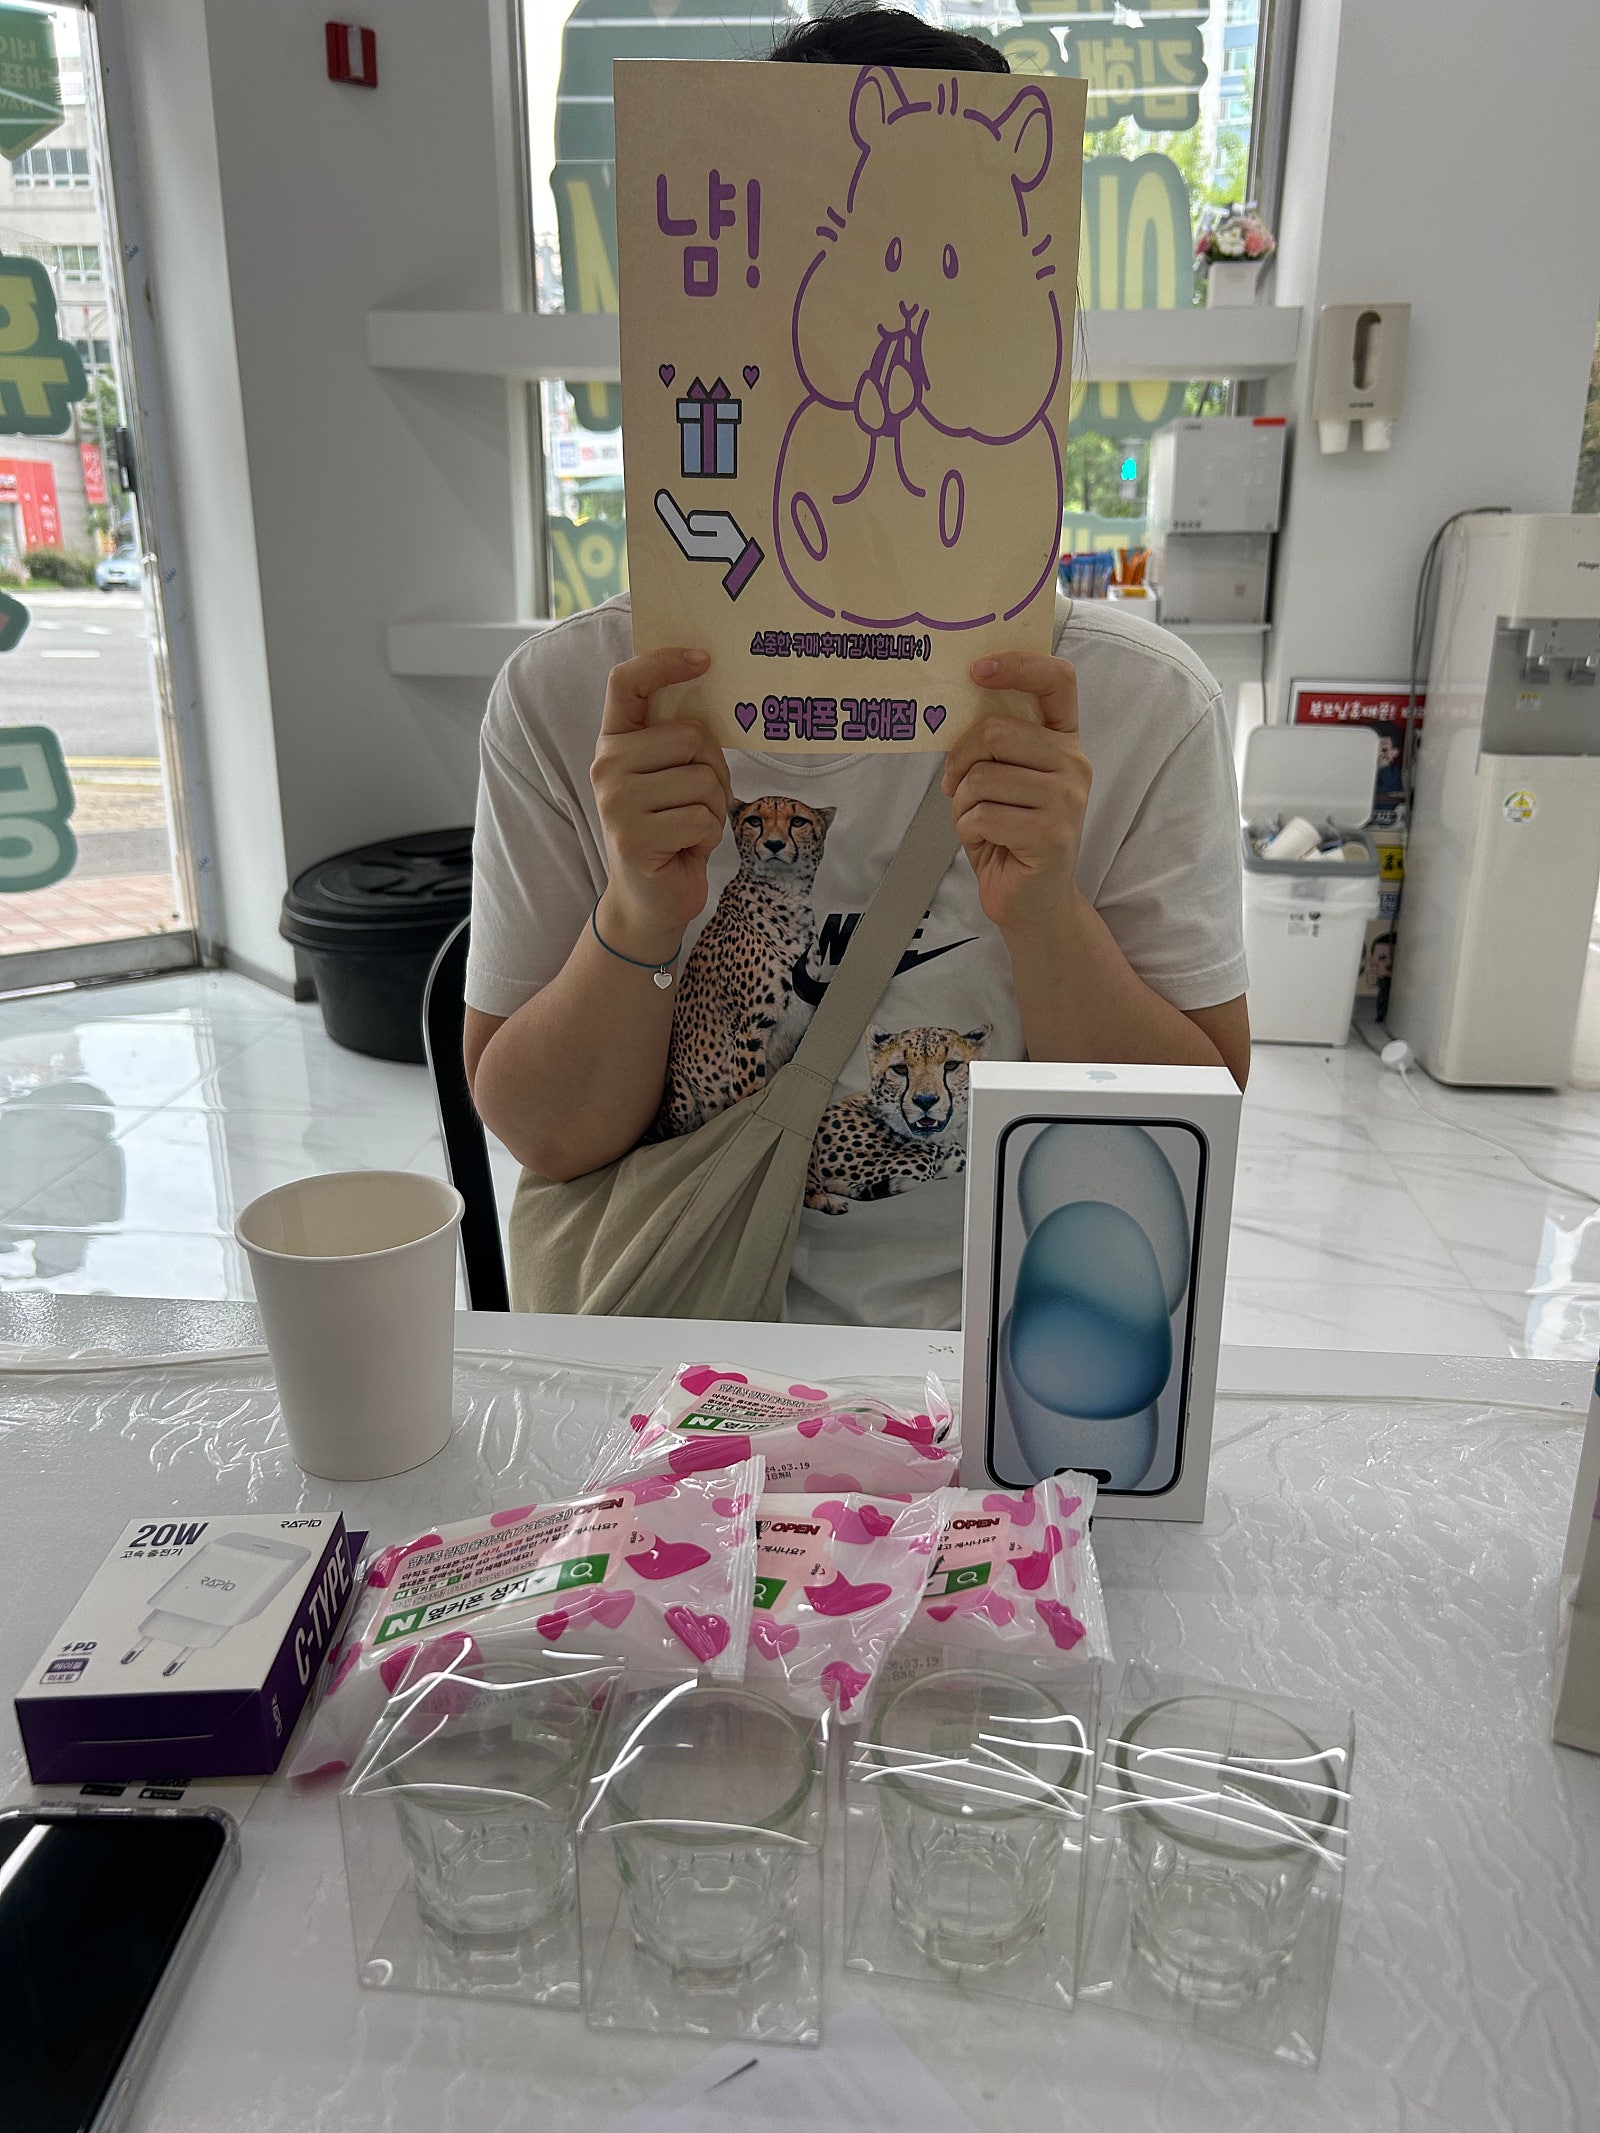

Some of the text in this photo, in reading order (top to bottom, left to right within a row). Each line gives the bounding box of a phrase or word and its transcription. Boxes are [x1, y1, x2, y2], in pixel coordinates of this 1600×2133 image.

[657, 169, 760, 297] 냠!
[750, 631, 791, 658] 소중한
[792, 633, 820, 658] 구매
[821, 633, 848, 659] 후기
[762, 696, 917, 741] 옆커폰 김해점
[574, 1498, 625, 1516] OPEN
[129, 1518, 322, 1548] 20W RAPID
[771, 1522, 820, 1535] OPEN
[953, 1518, 1000, 1529] OPEN
[120, 1547, 184, 1559] 고속 충전기
[398, 1578, 428, 1590] 휴대폰
[539, 1537, 550, 1547] 거
[474, 1550, 535, 1577] 검색해보세요!
[200, 1576, 235, 1591] RAPID
[402, 1569, 431, 1581] 아직도
[295, 1536, 351, 1686] C-TYPE
[384, 1613, 417, 1637] N
[427, 1591, 485, 1622] 옆커폰
[489, 1577, 530, 1602] 성지
[72, 1641, 97, 1652] PD
